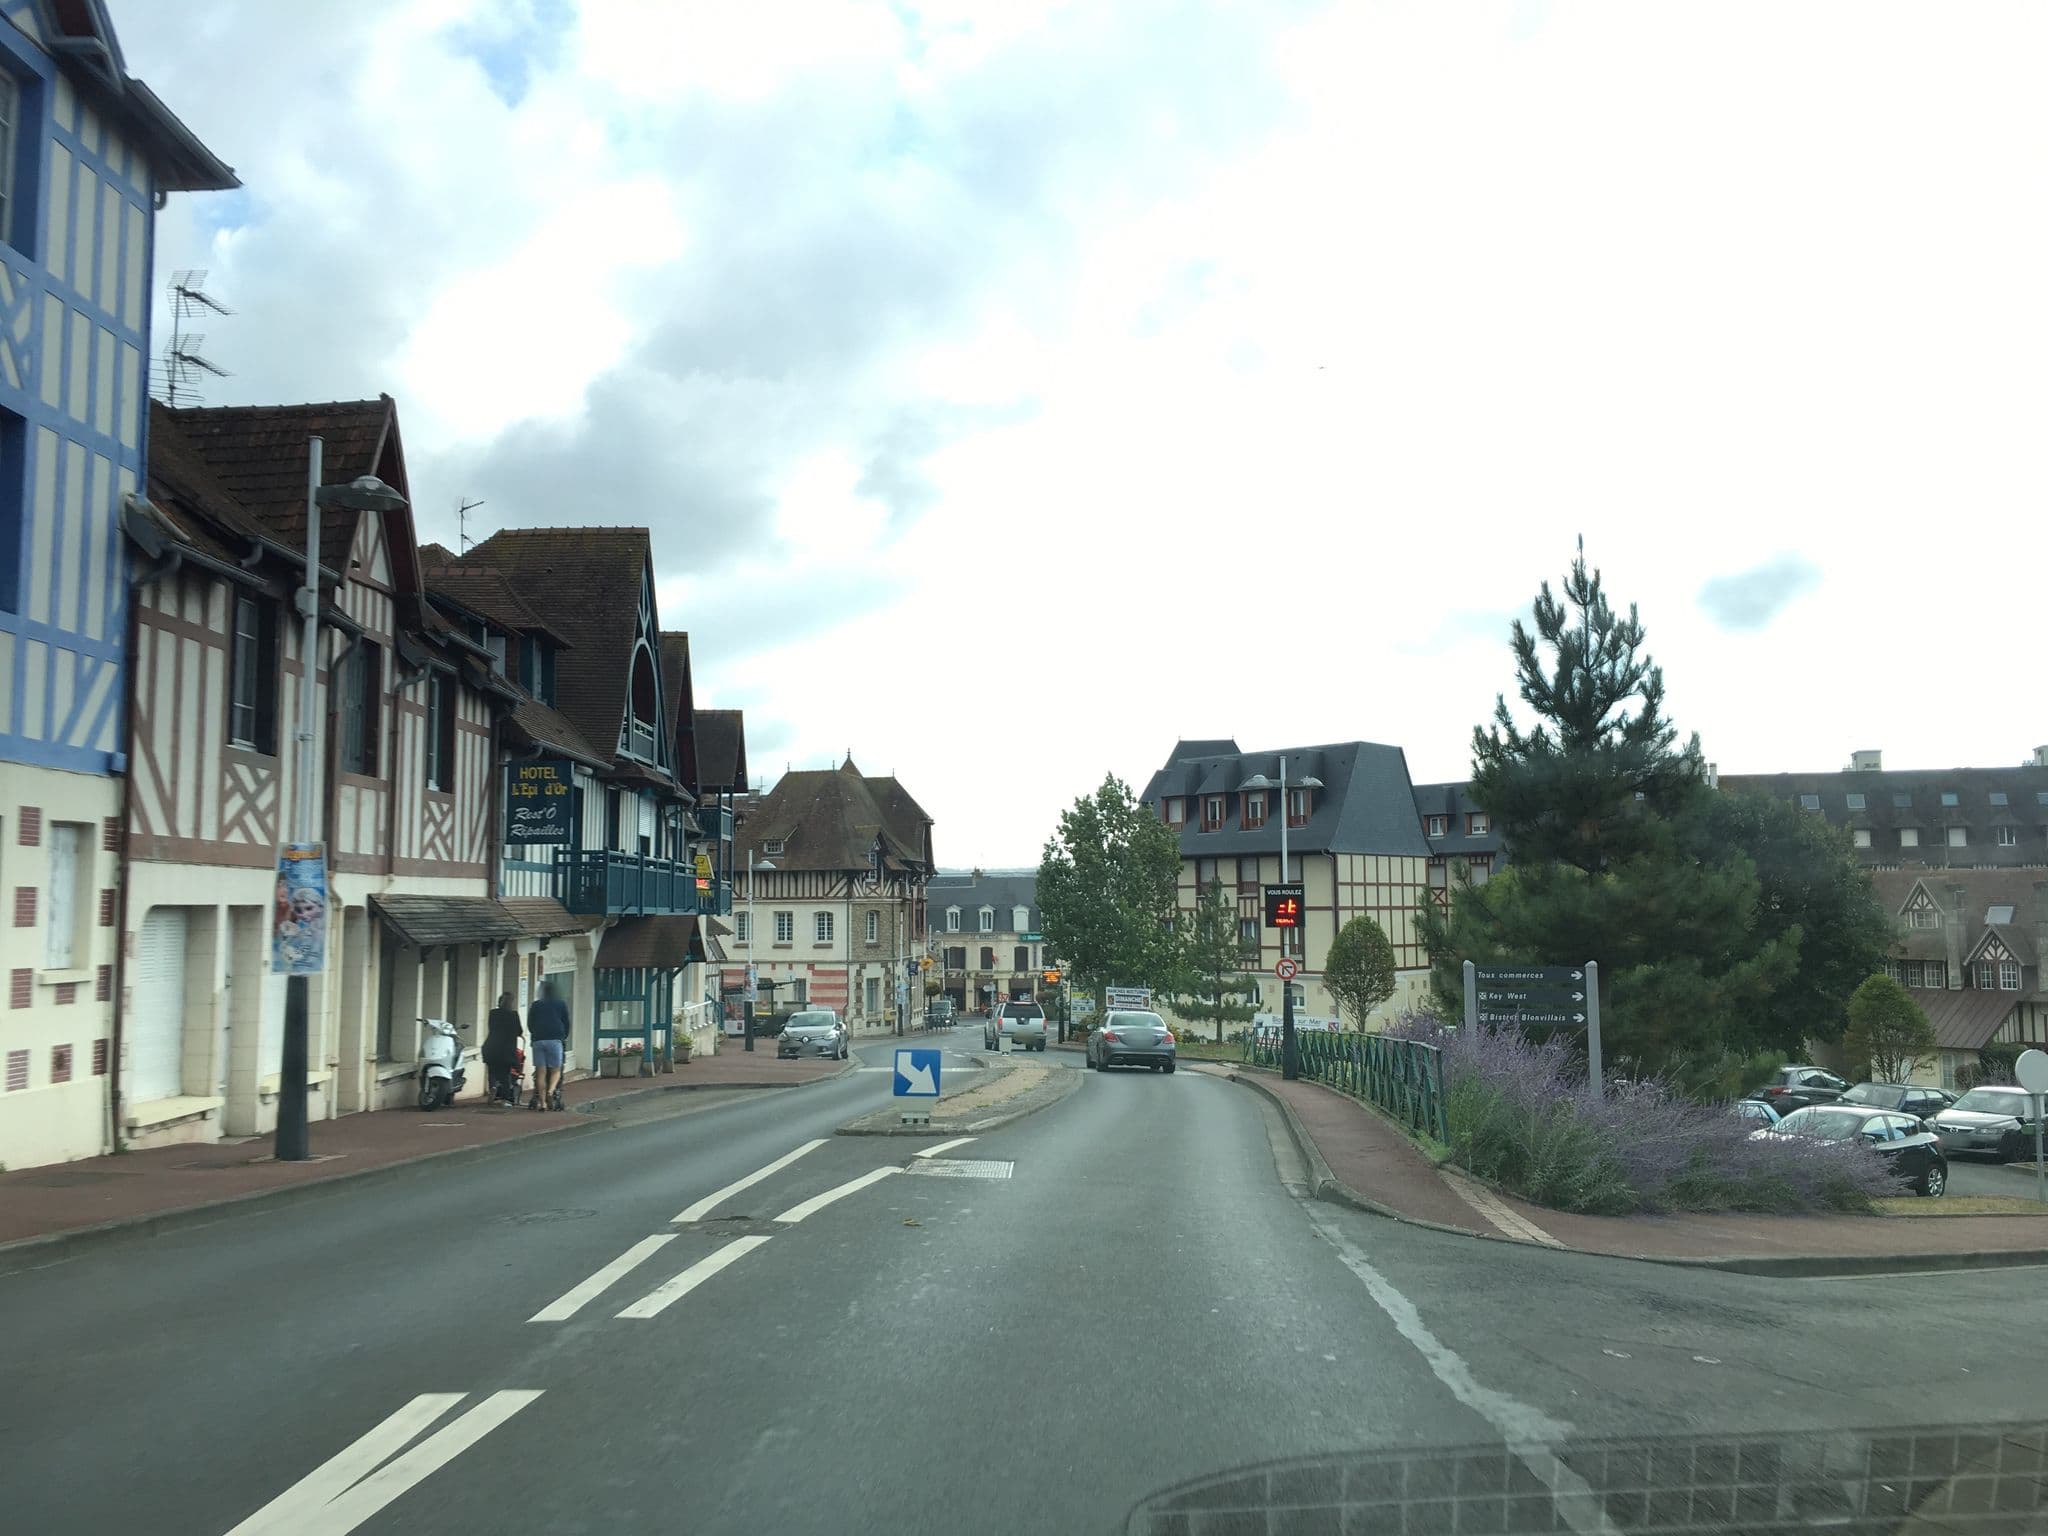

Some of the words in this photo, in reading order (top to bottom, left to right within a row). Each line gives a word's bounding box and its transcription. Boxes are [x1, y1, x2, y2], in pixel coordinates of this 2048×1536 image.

[519, 766, 558, 780] HOTEL
[1477, 971, 1495, 979] Tous
[1488, 992, 1503, 1001] Key
[1507, 992, 1527, 1000] West
[1521, 1013, 1566, 1021] Blonvillais
